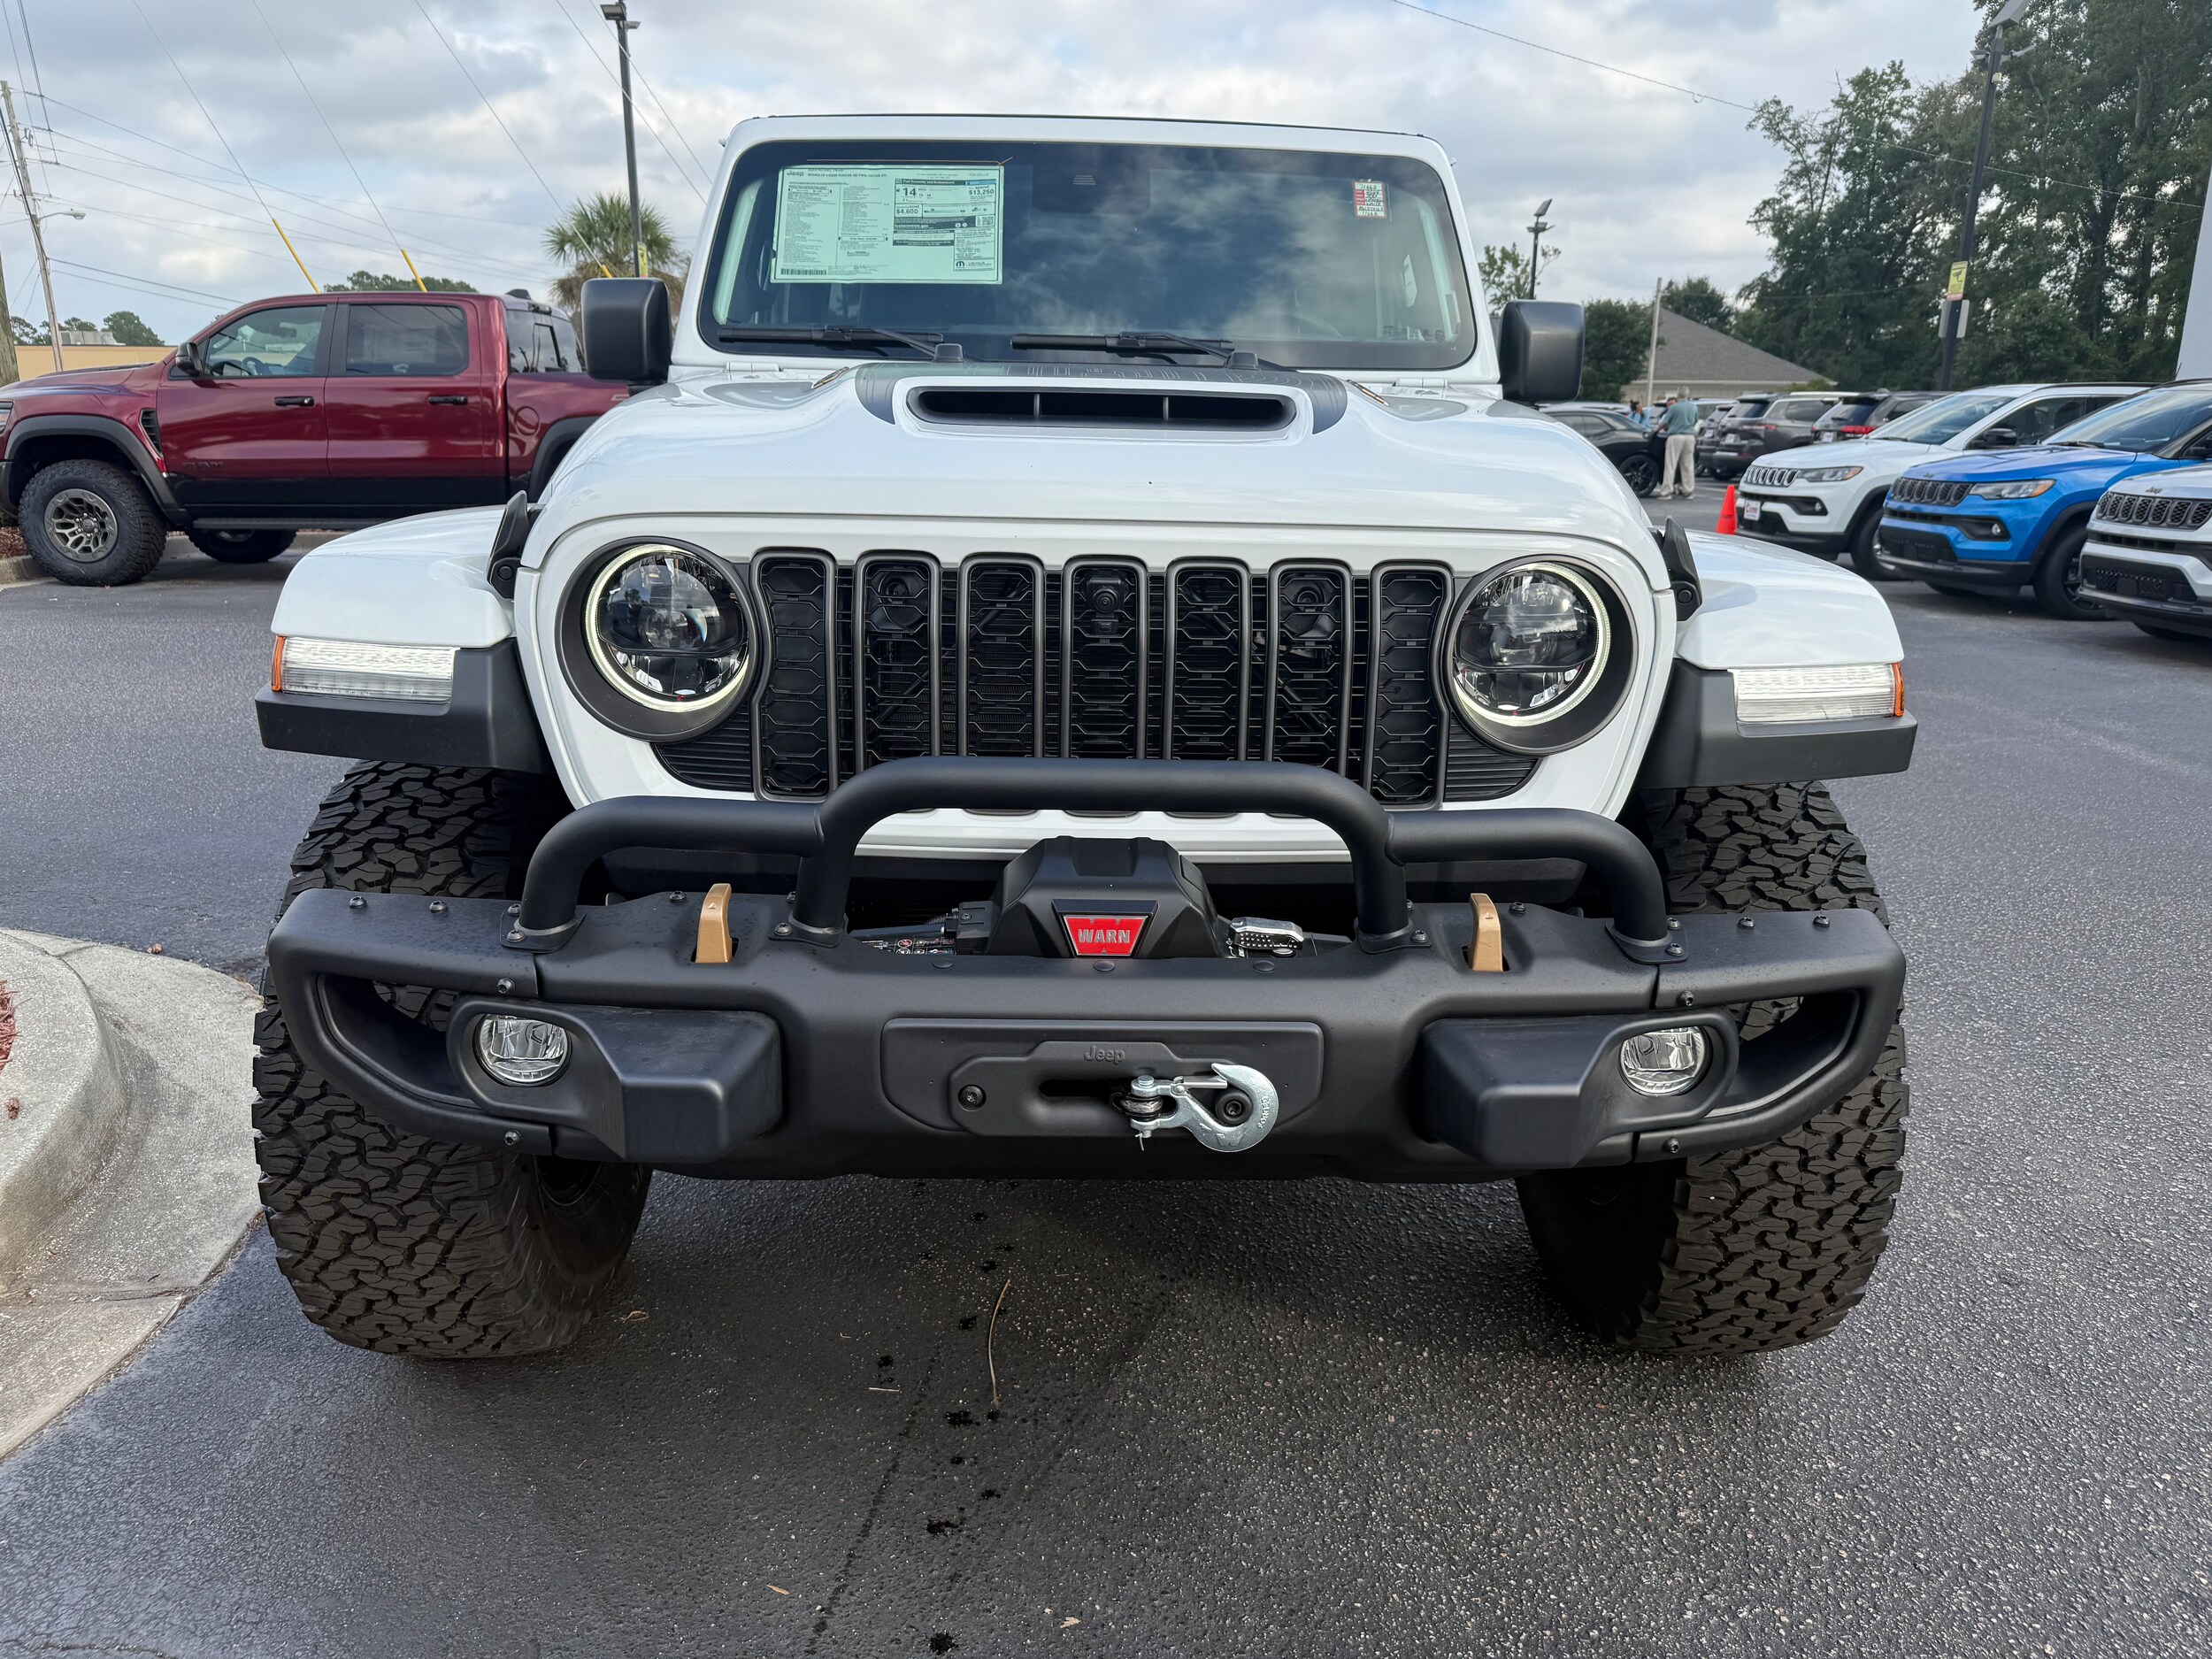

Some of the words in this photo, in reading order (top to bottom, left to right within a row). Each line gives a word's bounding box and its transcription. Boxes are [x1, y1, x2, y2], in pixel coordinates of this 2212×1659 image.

[902, 187, 917, 196] 14
[1078, 928, 1131, 944] WARN
[1083, 1045, 1125, 1064] Jeep
